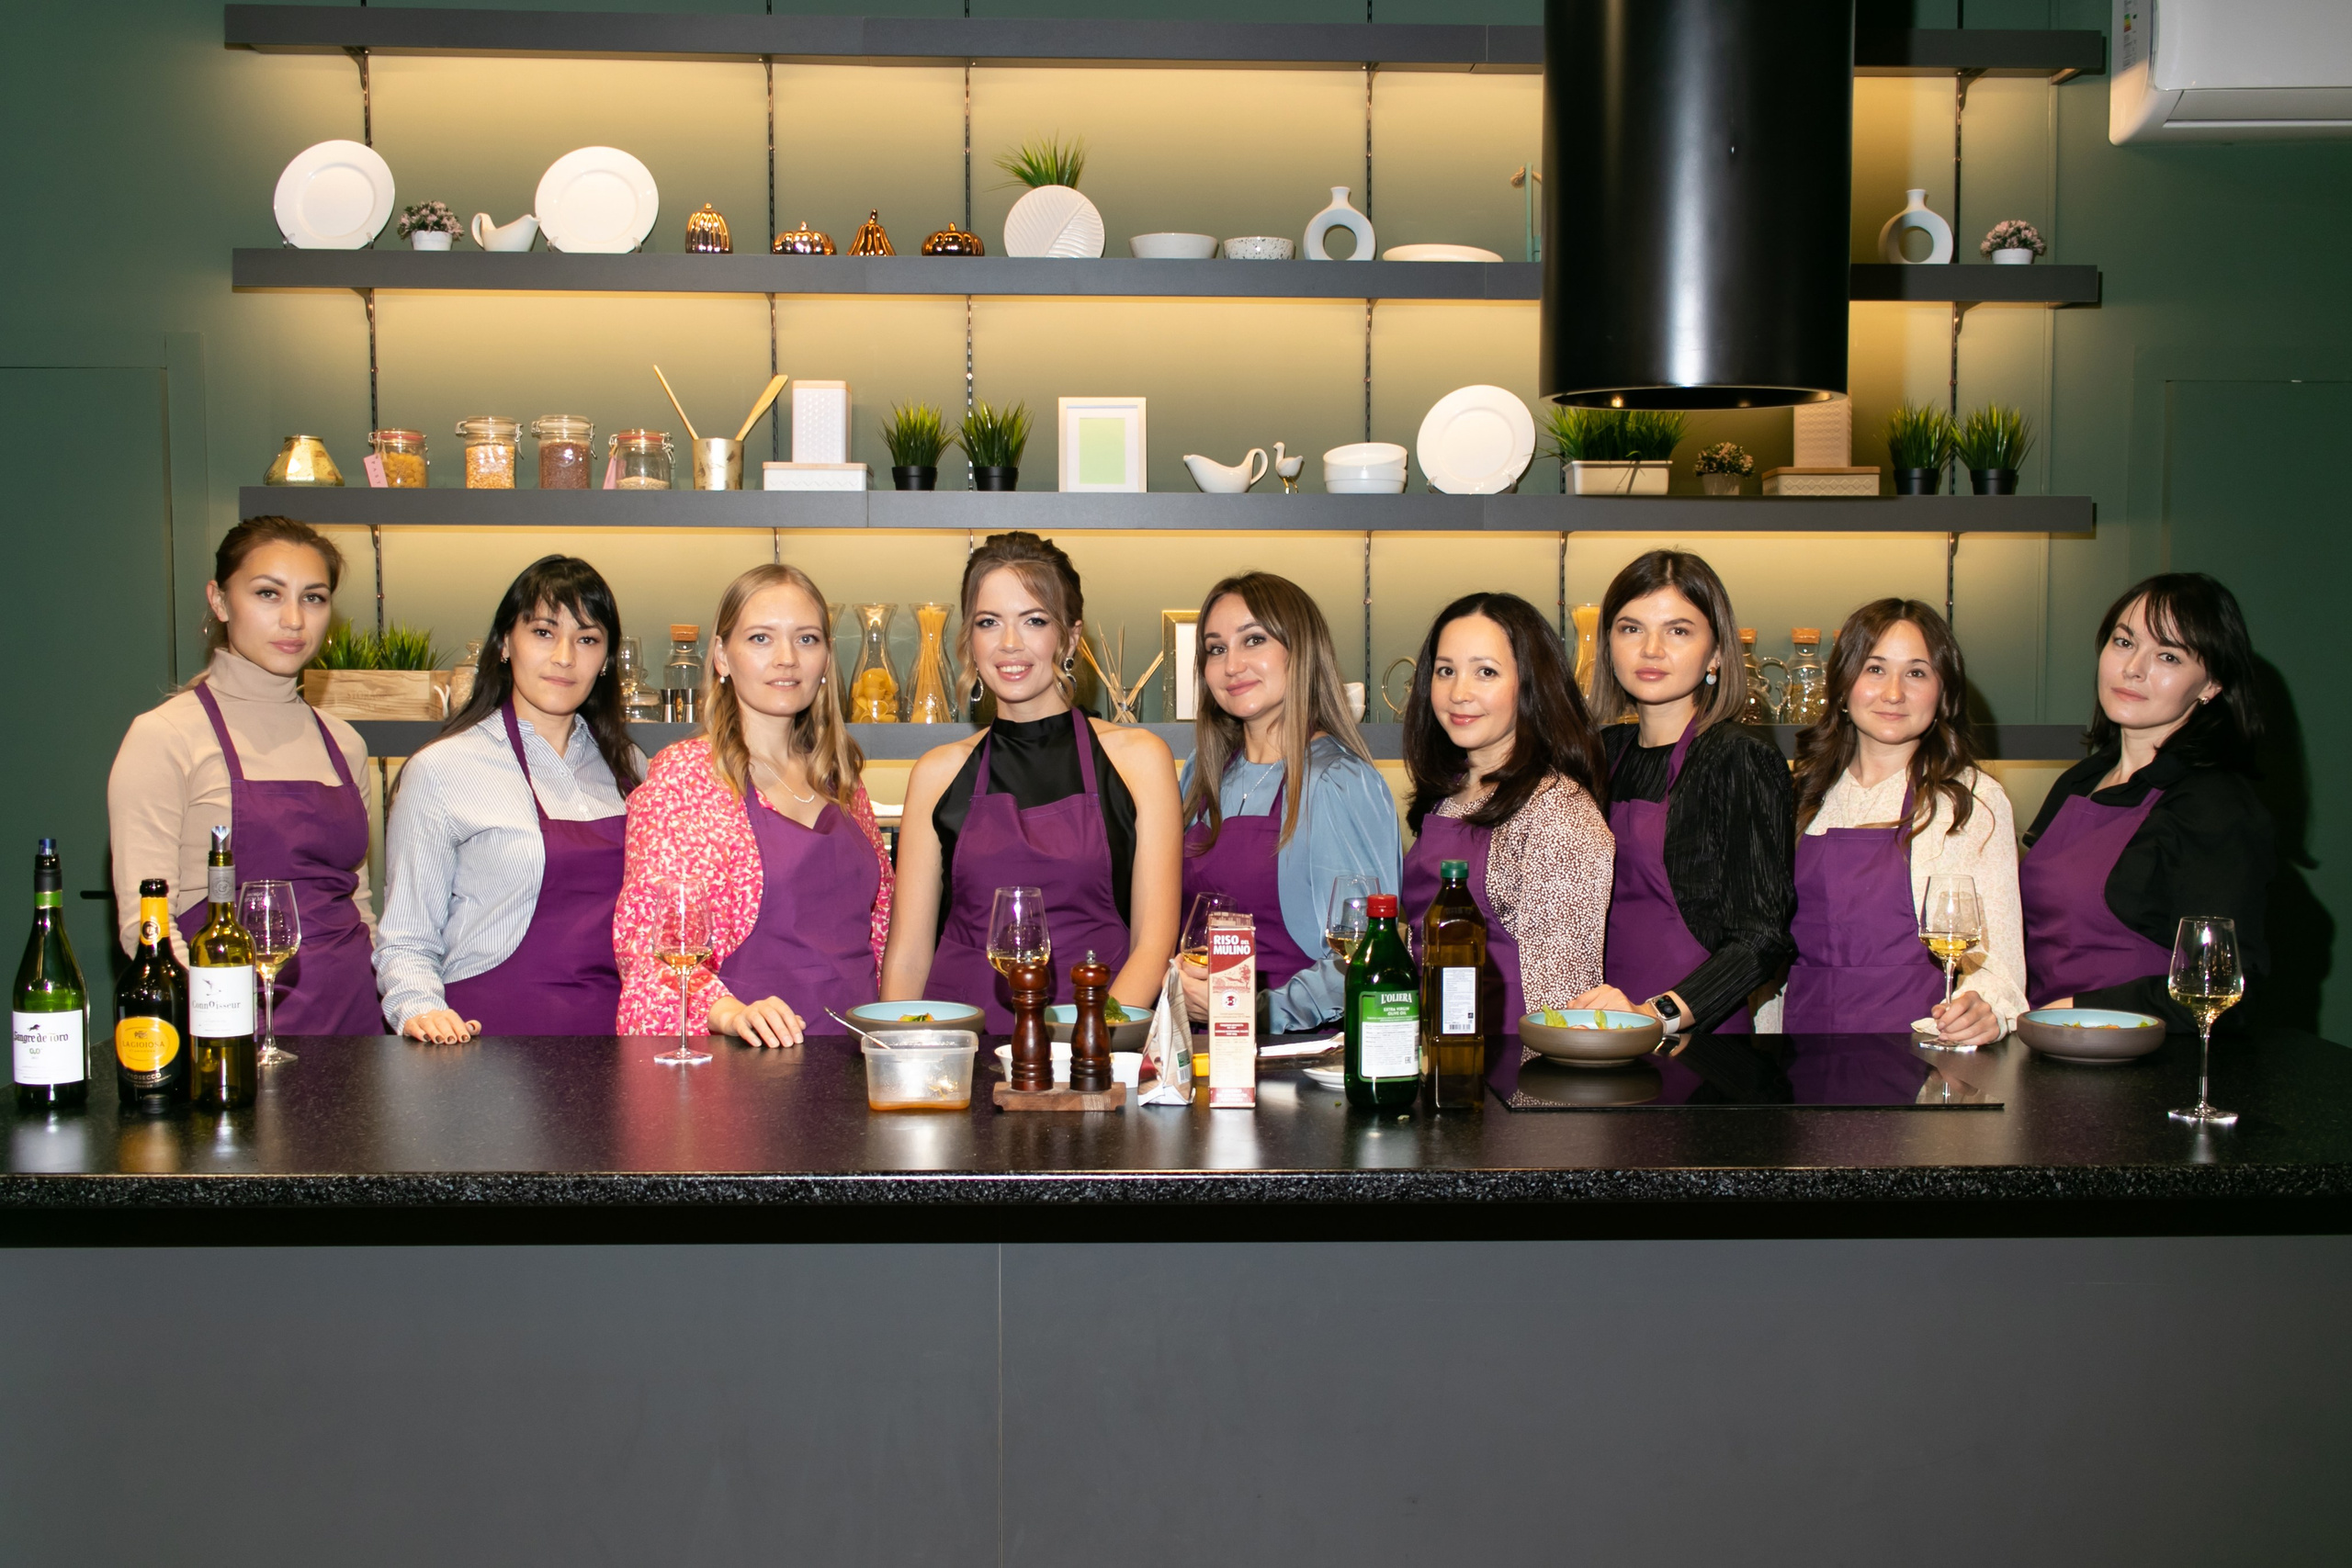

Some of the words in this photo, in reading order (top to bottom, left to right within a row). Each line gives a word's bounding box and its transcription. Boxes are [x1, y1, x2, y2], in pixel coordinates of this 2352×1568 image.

[1213, 934, 1239, 945] RISO
[1213, 945, 1251, 955] MULINO
[1381, 993, 1412, 1005] L'OLIERA
[14, 1031, 35, 1043] Sangre
[37, 1033, 48, 1043] de
[48, 1033, 69, 1042] Toro
[127, 1072, 162, 1080] PROSECCO
